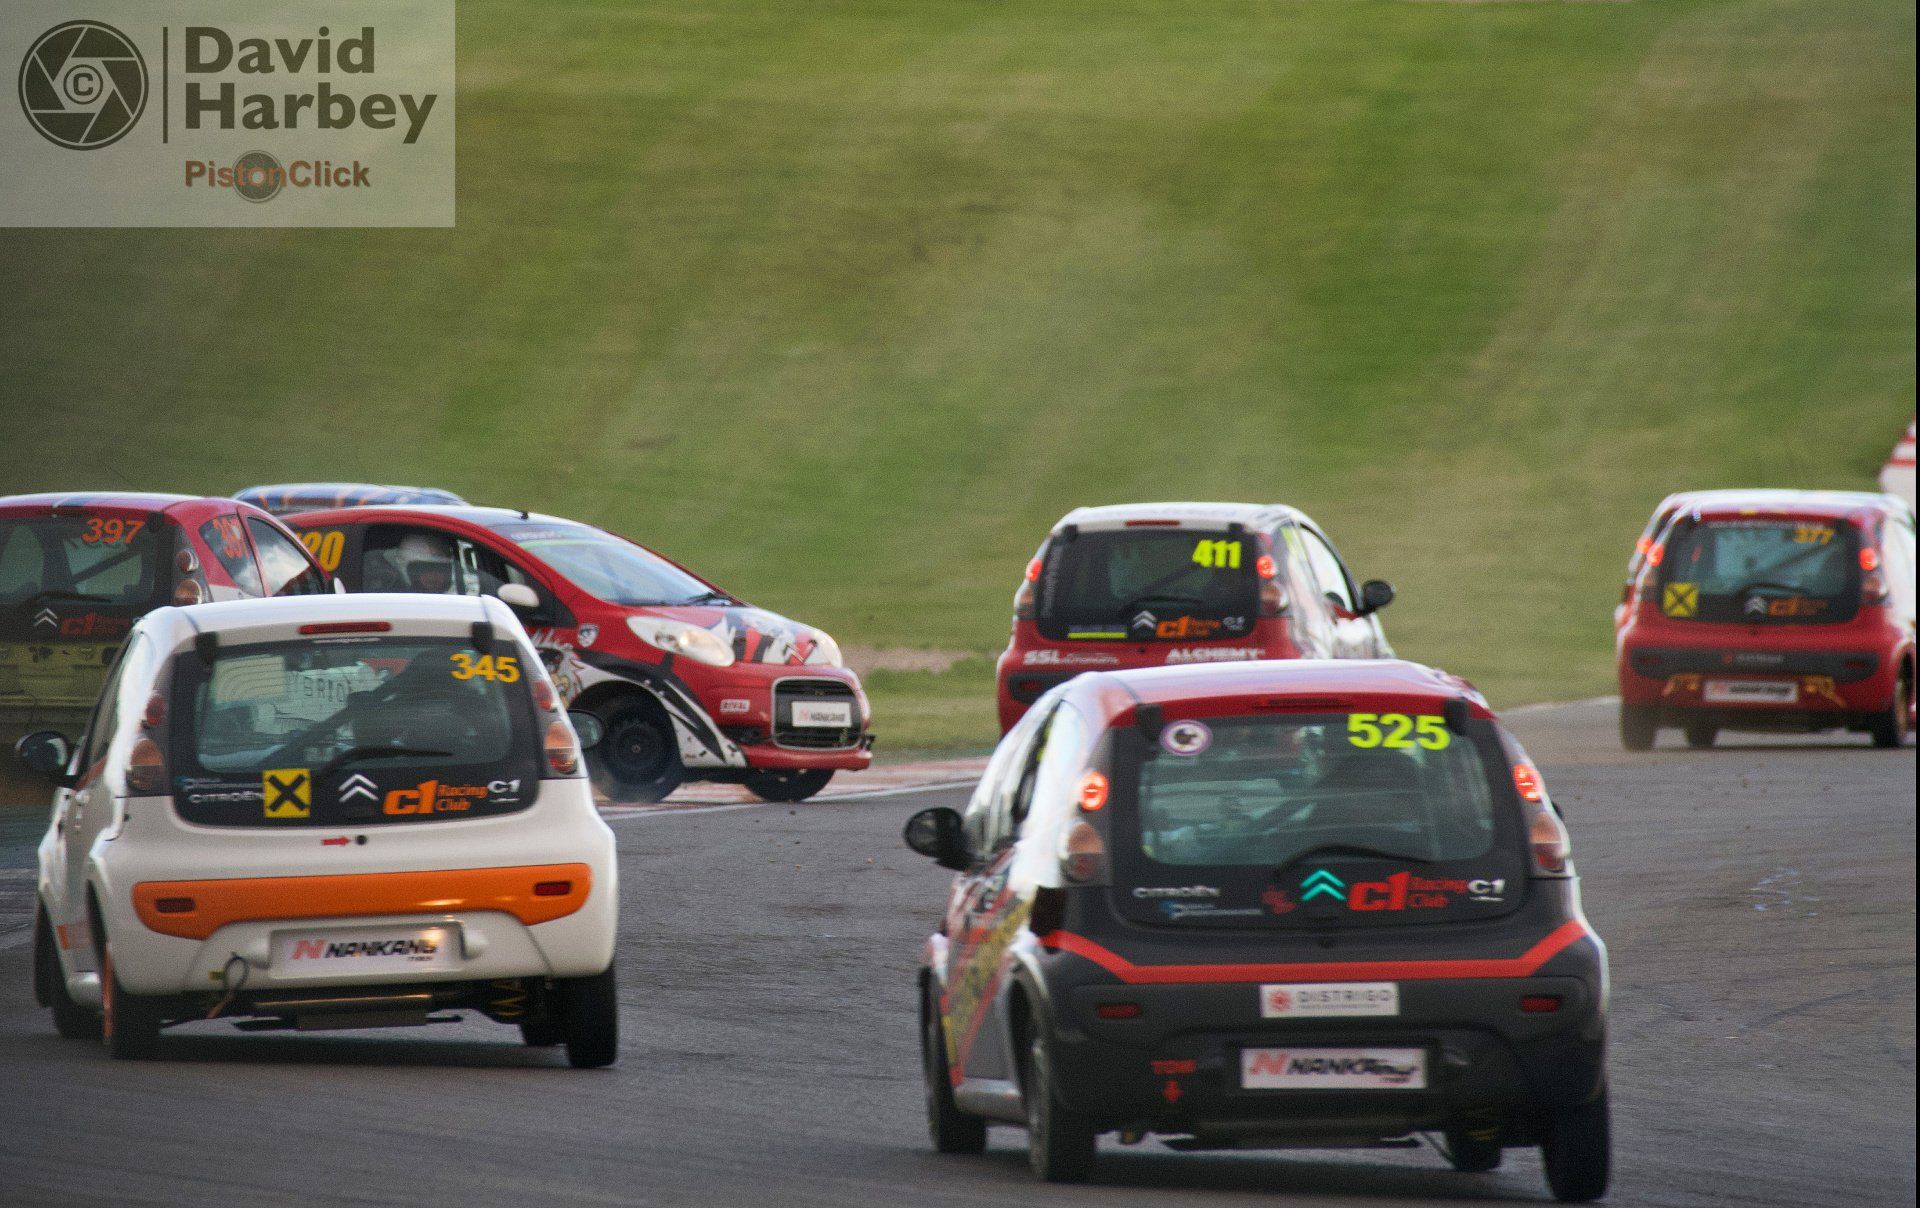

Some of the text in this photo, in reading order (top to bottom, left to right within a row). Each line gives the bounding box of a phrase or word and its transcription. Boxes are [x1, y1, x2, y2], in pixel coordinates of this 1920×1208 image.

[82, 518, 145, 543] 397
[296, 530, 345, 572] 20
[1192, 540, 1242, 569] 411
[1023, 649, 1060, 666] SSL
[1166, 647, 1258, 660] ALCHEMY
[450, 652, 520, 684] 345
[1347, 713, 1452, 751] 525
[437, 784, 489, 799] Racing
[487, 780, 521, 793] C1
[436, 798, 471, 811] Club
[1468, 879, 1506, 894] C1
[1297, 989, 1392, 1003] DISTRIGO
